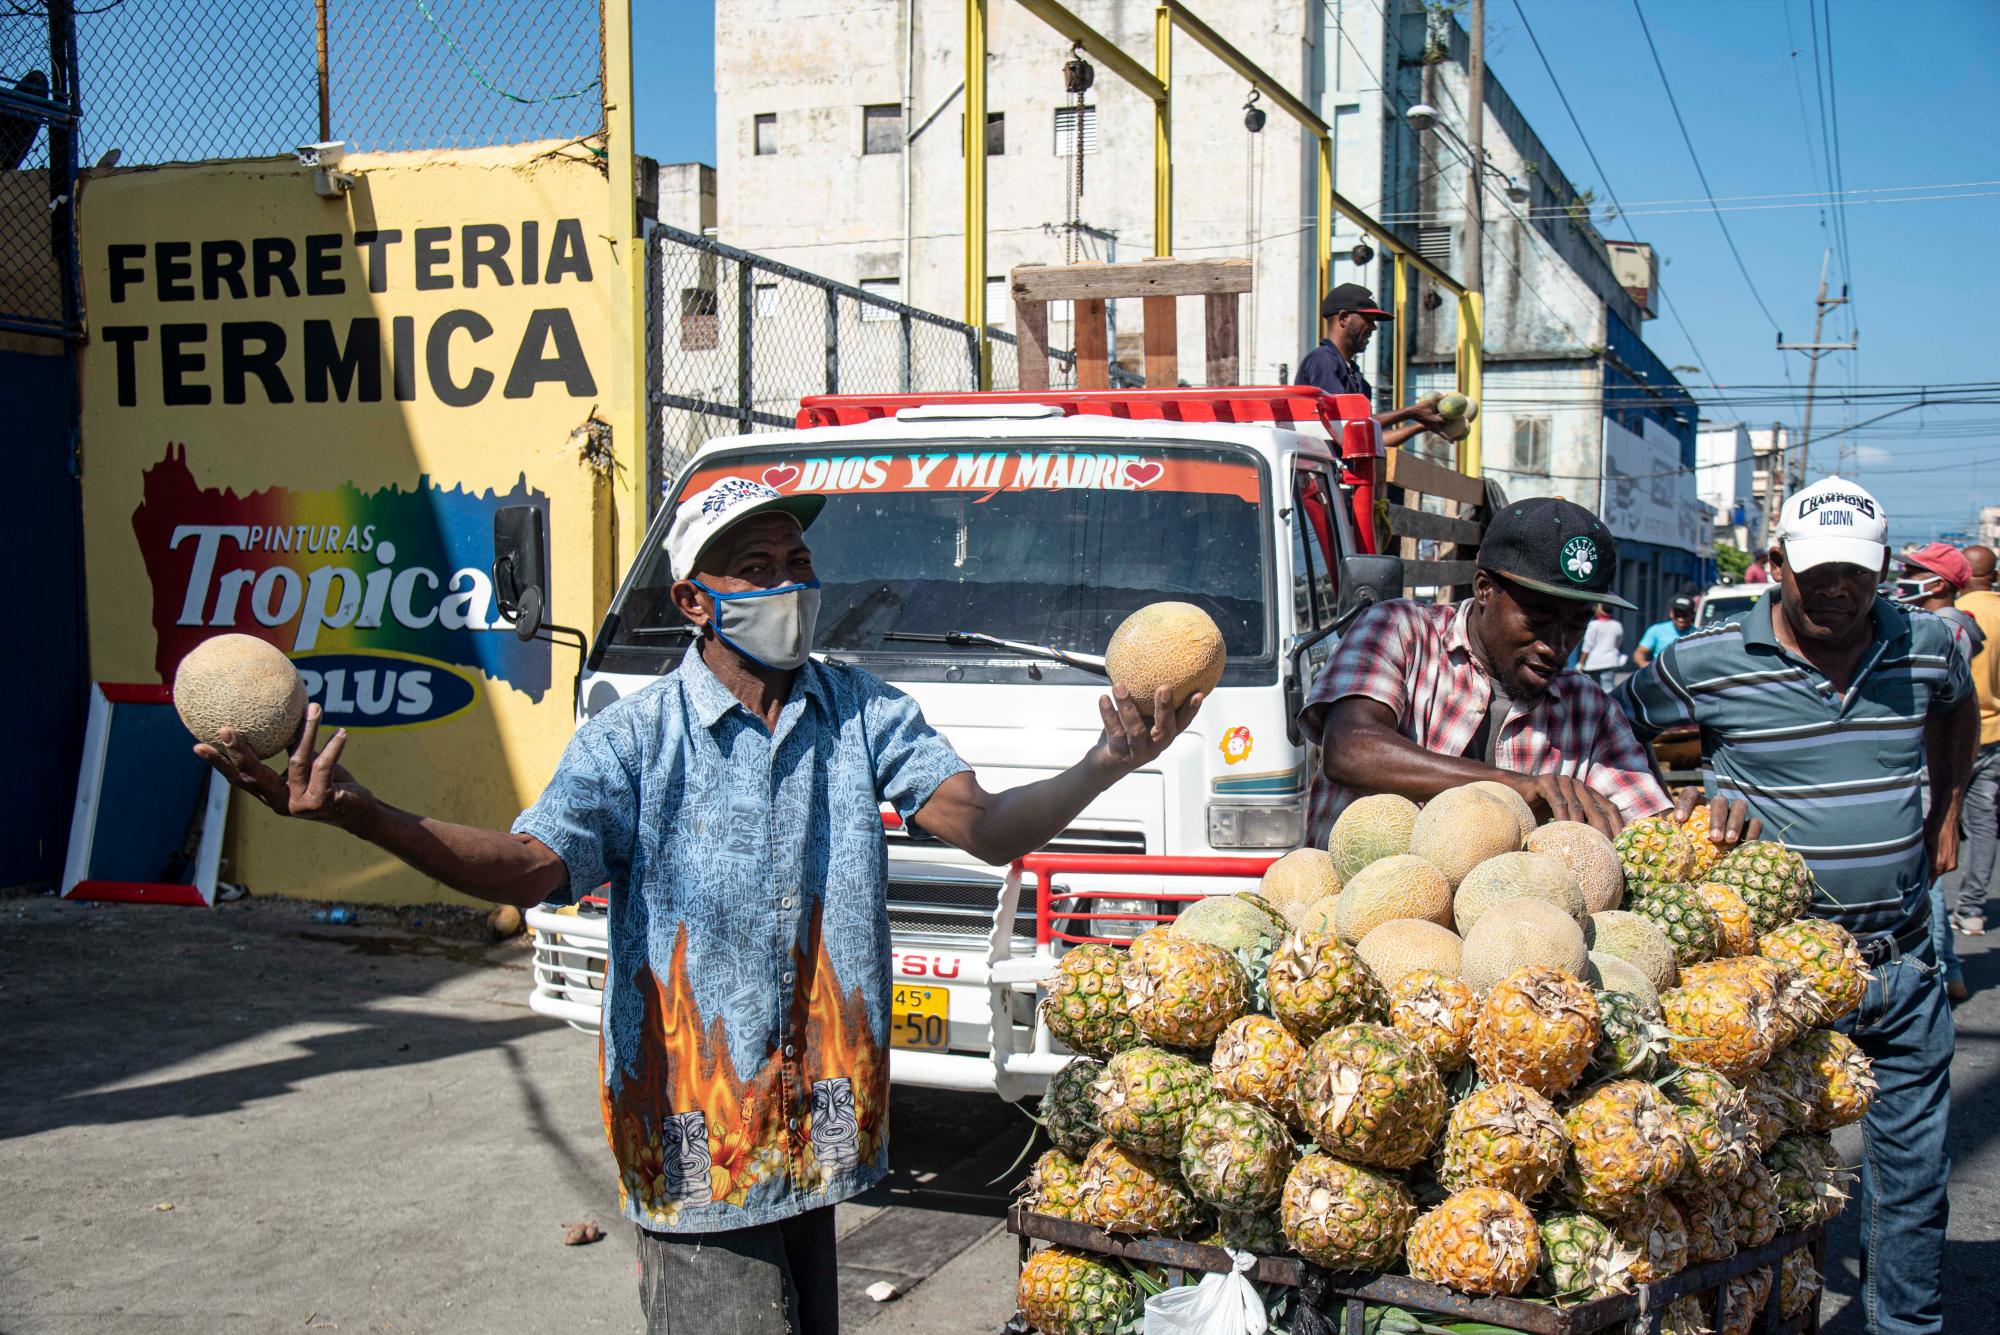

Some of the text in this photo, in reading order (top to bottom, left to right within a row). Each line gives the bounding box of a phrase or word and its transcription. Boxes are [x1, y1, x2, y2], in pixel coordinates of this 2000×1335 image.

[107, 218, 593, 302] FERRETERIA
[102, 307, 598, 407] TERMICA
[793, 452, 1141, 492] DIOS Y MI MADRE
[1798, 492, 1875, 520] CHAMPIONS
[1819, 510, 1853, 526] UCONN
[249, 525, 375, 552] PINTURAS
[1564, 539, 1598, 561] CELTICS
[169, 525, 518, 651] Tropica
